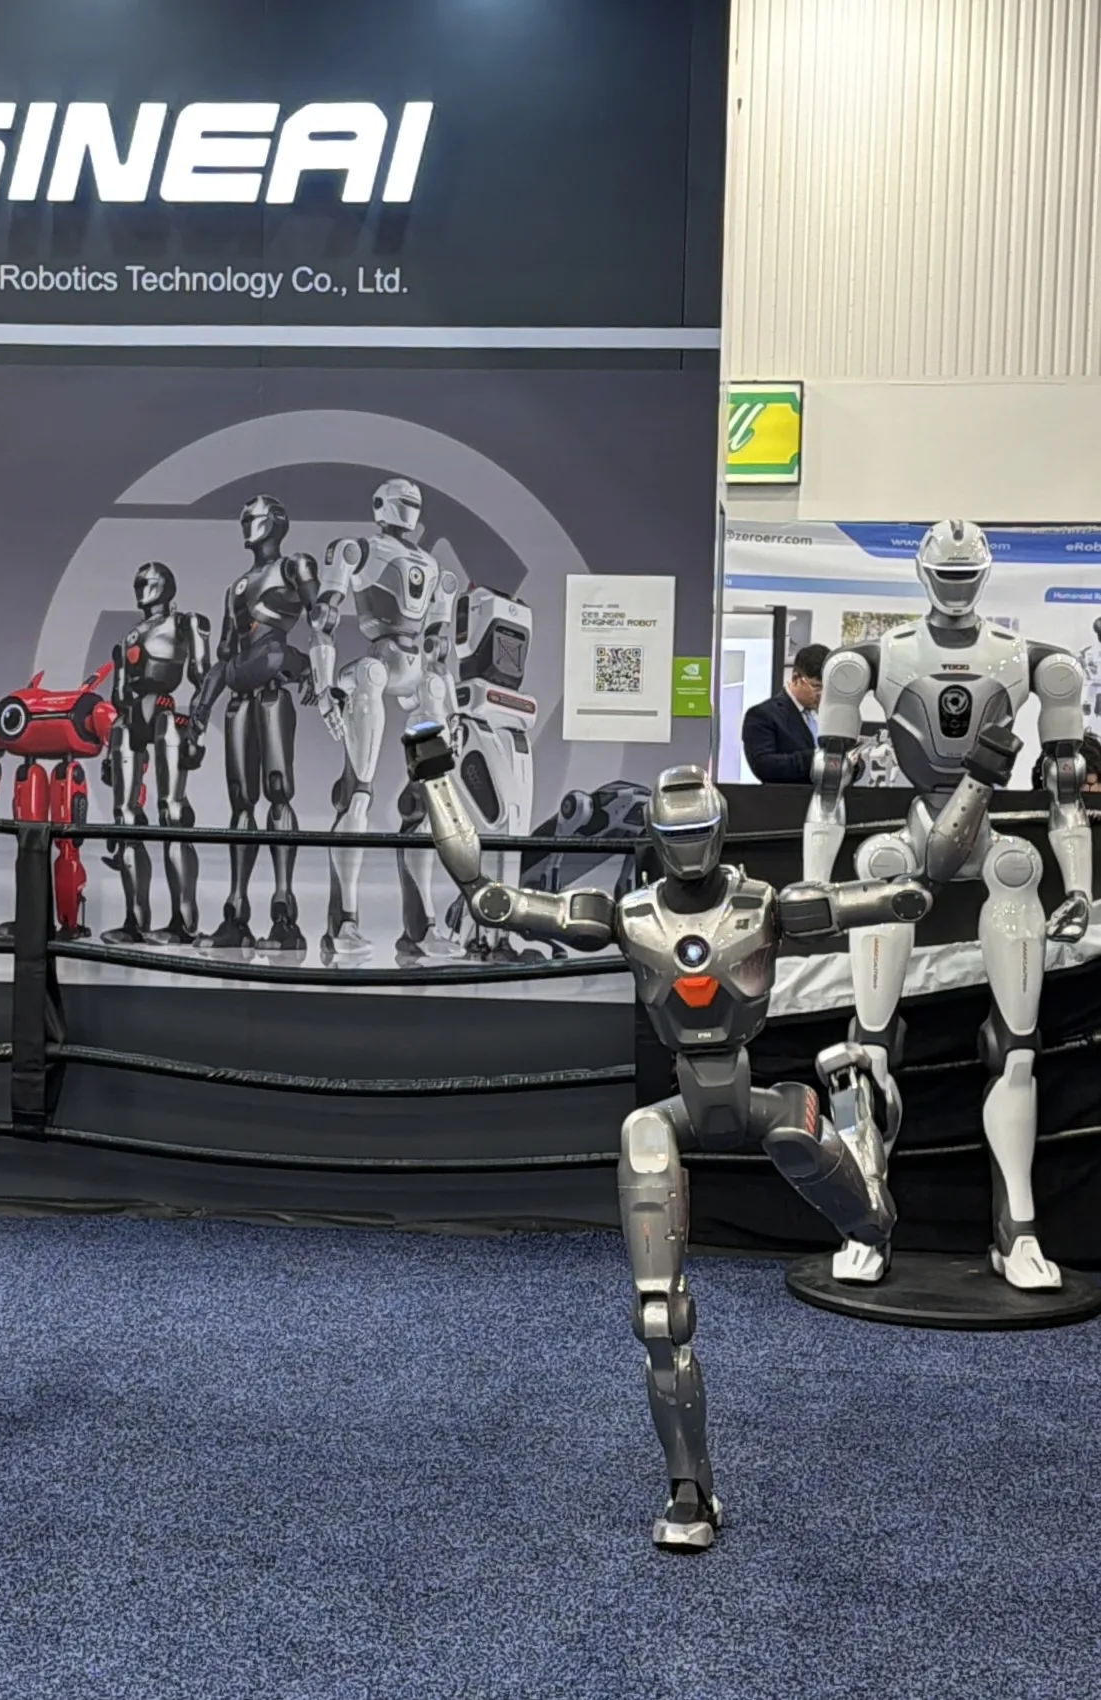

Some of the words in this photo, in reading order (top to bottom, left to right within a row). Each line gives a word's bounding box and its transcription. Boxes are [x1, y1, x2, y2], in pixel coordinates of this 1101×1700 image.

[0, 264, 118, 292] Robotics
[125, 266, 283, 298] Technology
[292, 266, 348, 296] Co.,
[358, 267, 408, 294] Ltd.
[627, 620, 658, 628] ROBOT
